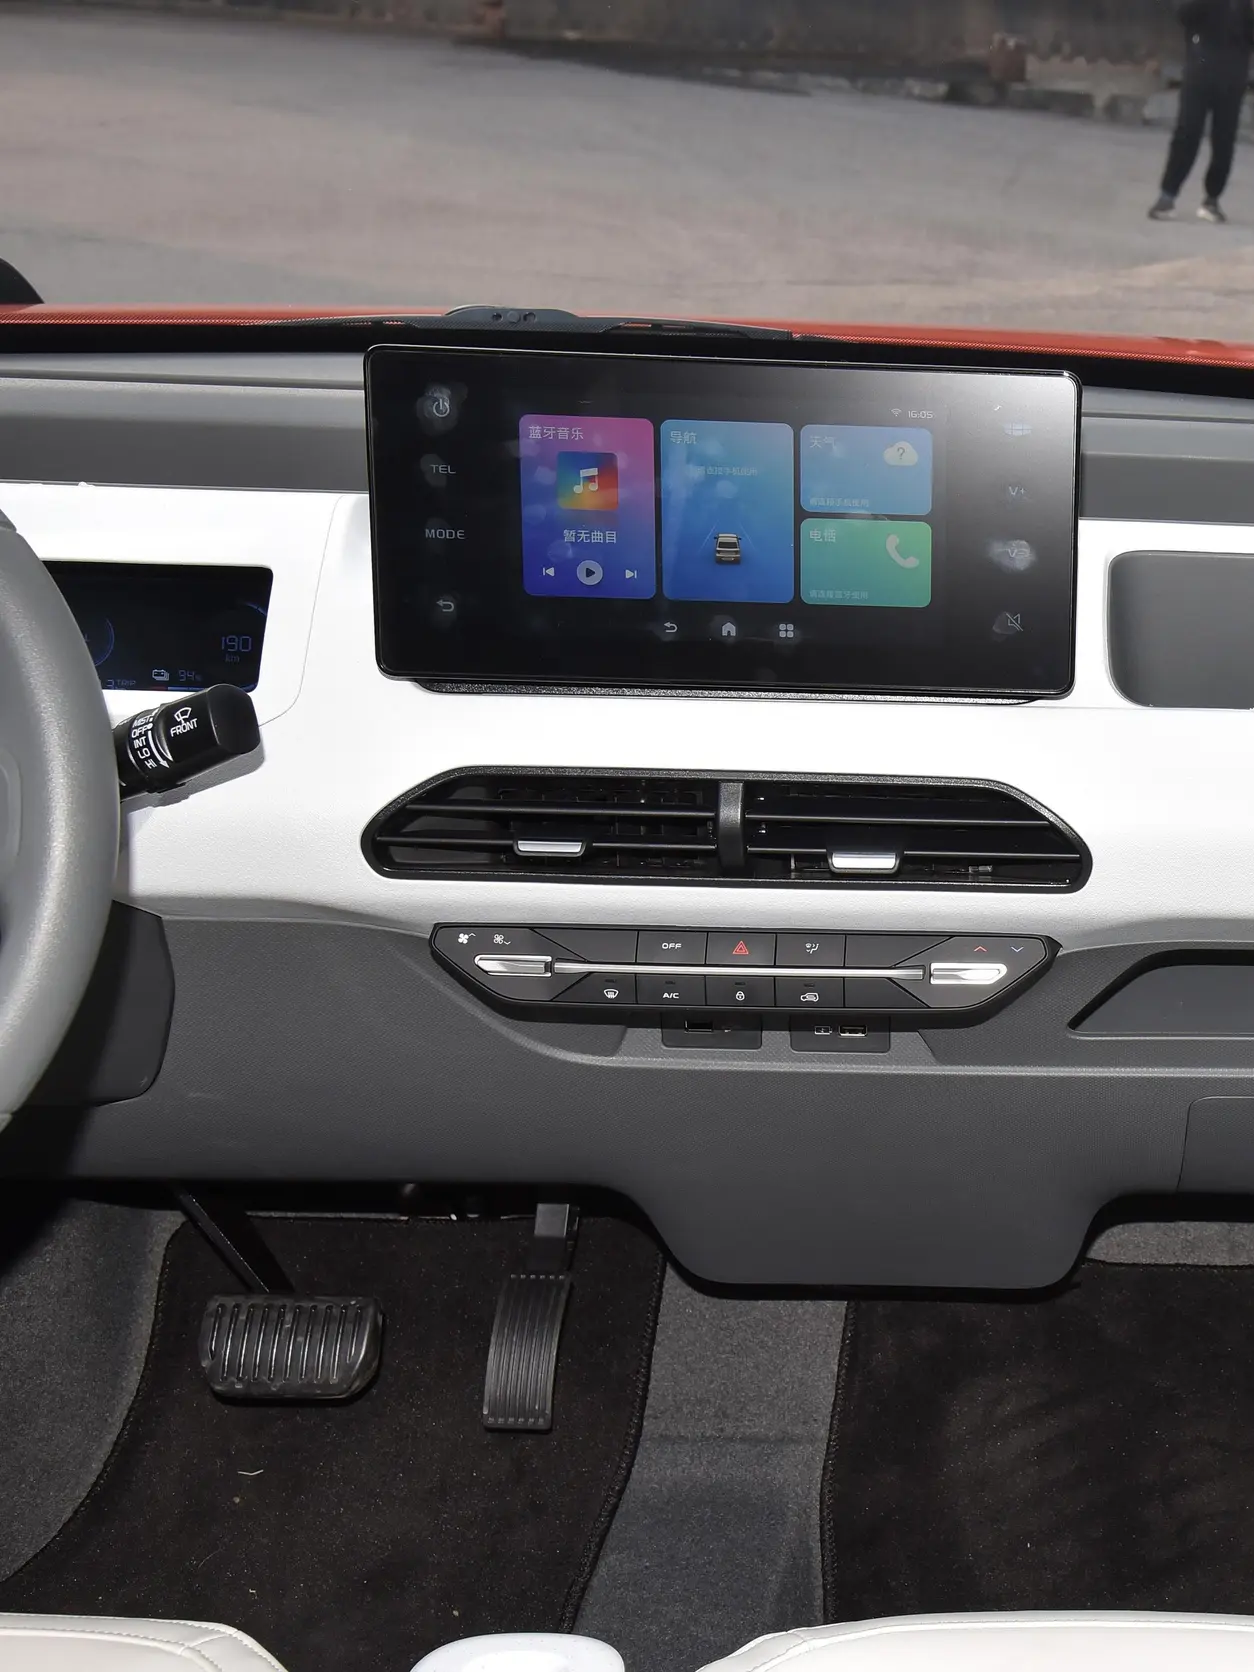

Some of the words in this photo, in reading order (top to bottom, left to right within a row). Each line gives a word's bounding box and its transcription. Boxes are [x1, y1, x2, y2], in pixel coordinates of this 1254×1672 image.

[906, 409, 934, 420] 16:05
[527, 424, 585, 441] 蓝牙音乐
[669, 430, 698, 445] 导航
[809, 434, 837, 450] 天气
[429, 463, 457, 475] TEL
[424, 528, 466, 541] MODE
[562, 529, 618, 544] 暂无曲目
[809, 528, 837, 543] 电话
[221, 635, 253, 652] 190
[132, 726, 148, 738] OFF
[170, 719, 197, 737] FRONT
[134, 737, 147, 749] INT
[138, 748, 151, 759] LO
[145, 759, 157, 769] HI
[661, 942, 682, 950] OFF
